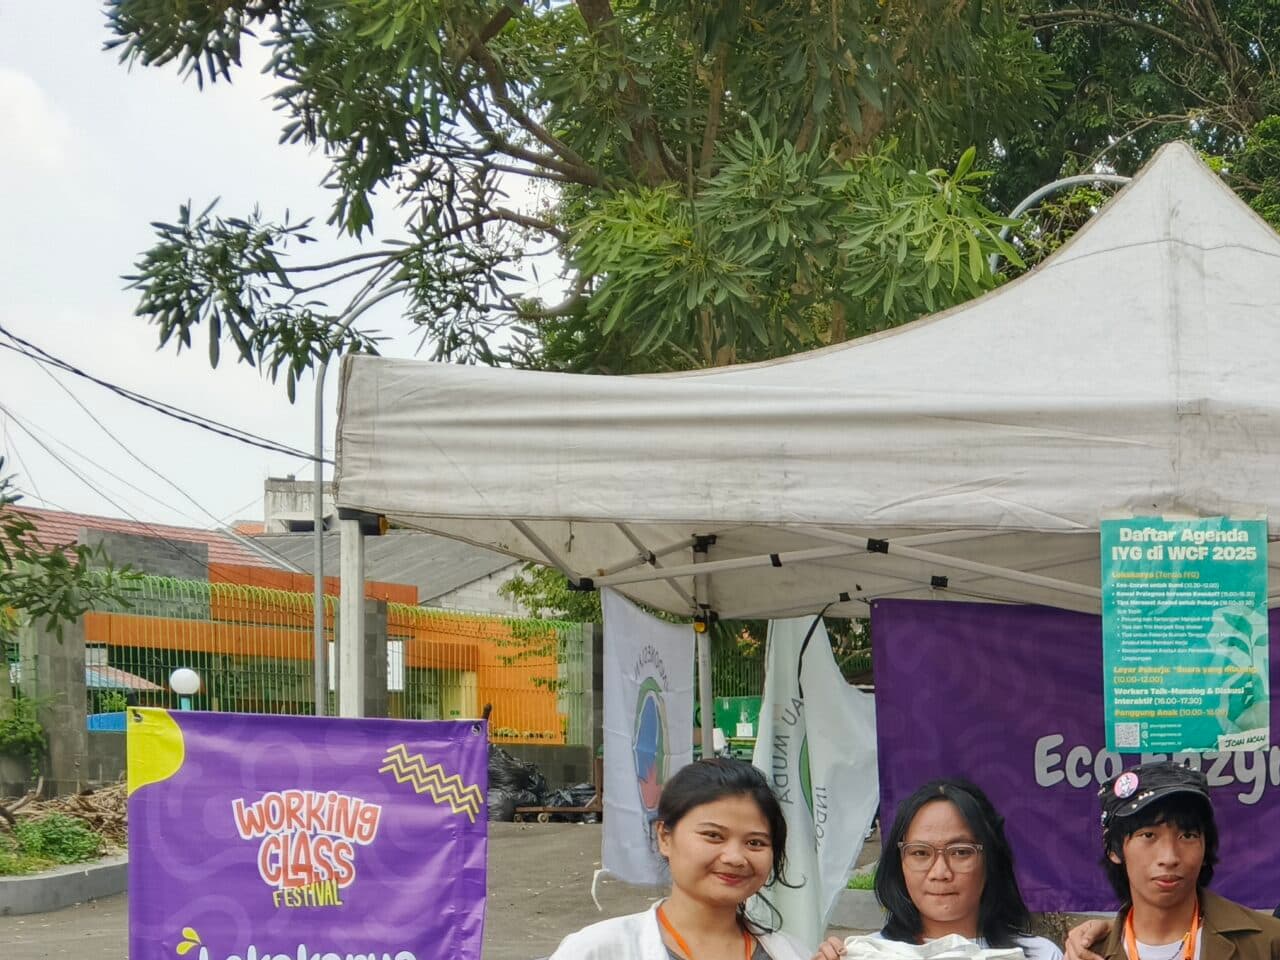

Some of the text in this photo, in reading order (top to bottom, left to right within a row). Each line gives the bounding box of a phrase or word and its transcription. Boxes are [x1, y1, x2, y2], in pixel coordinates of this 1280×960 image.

[1119, 527, 1249, 544] Daftar Agenda
[1112, 546, 1257, 561] IYG di WCF 2025
[1033, 733, 1123, 788] Eco
[257, 830, 356, 889] CLASS
[272, 878, 344, 908] FESTIVAL
